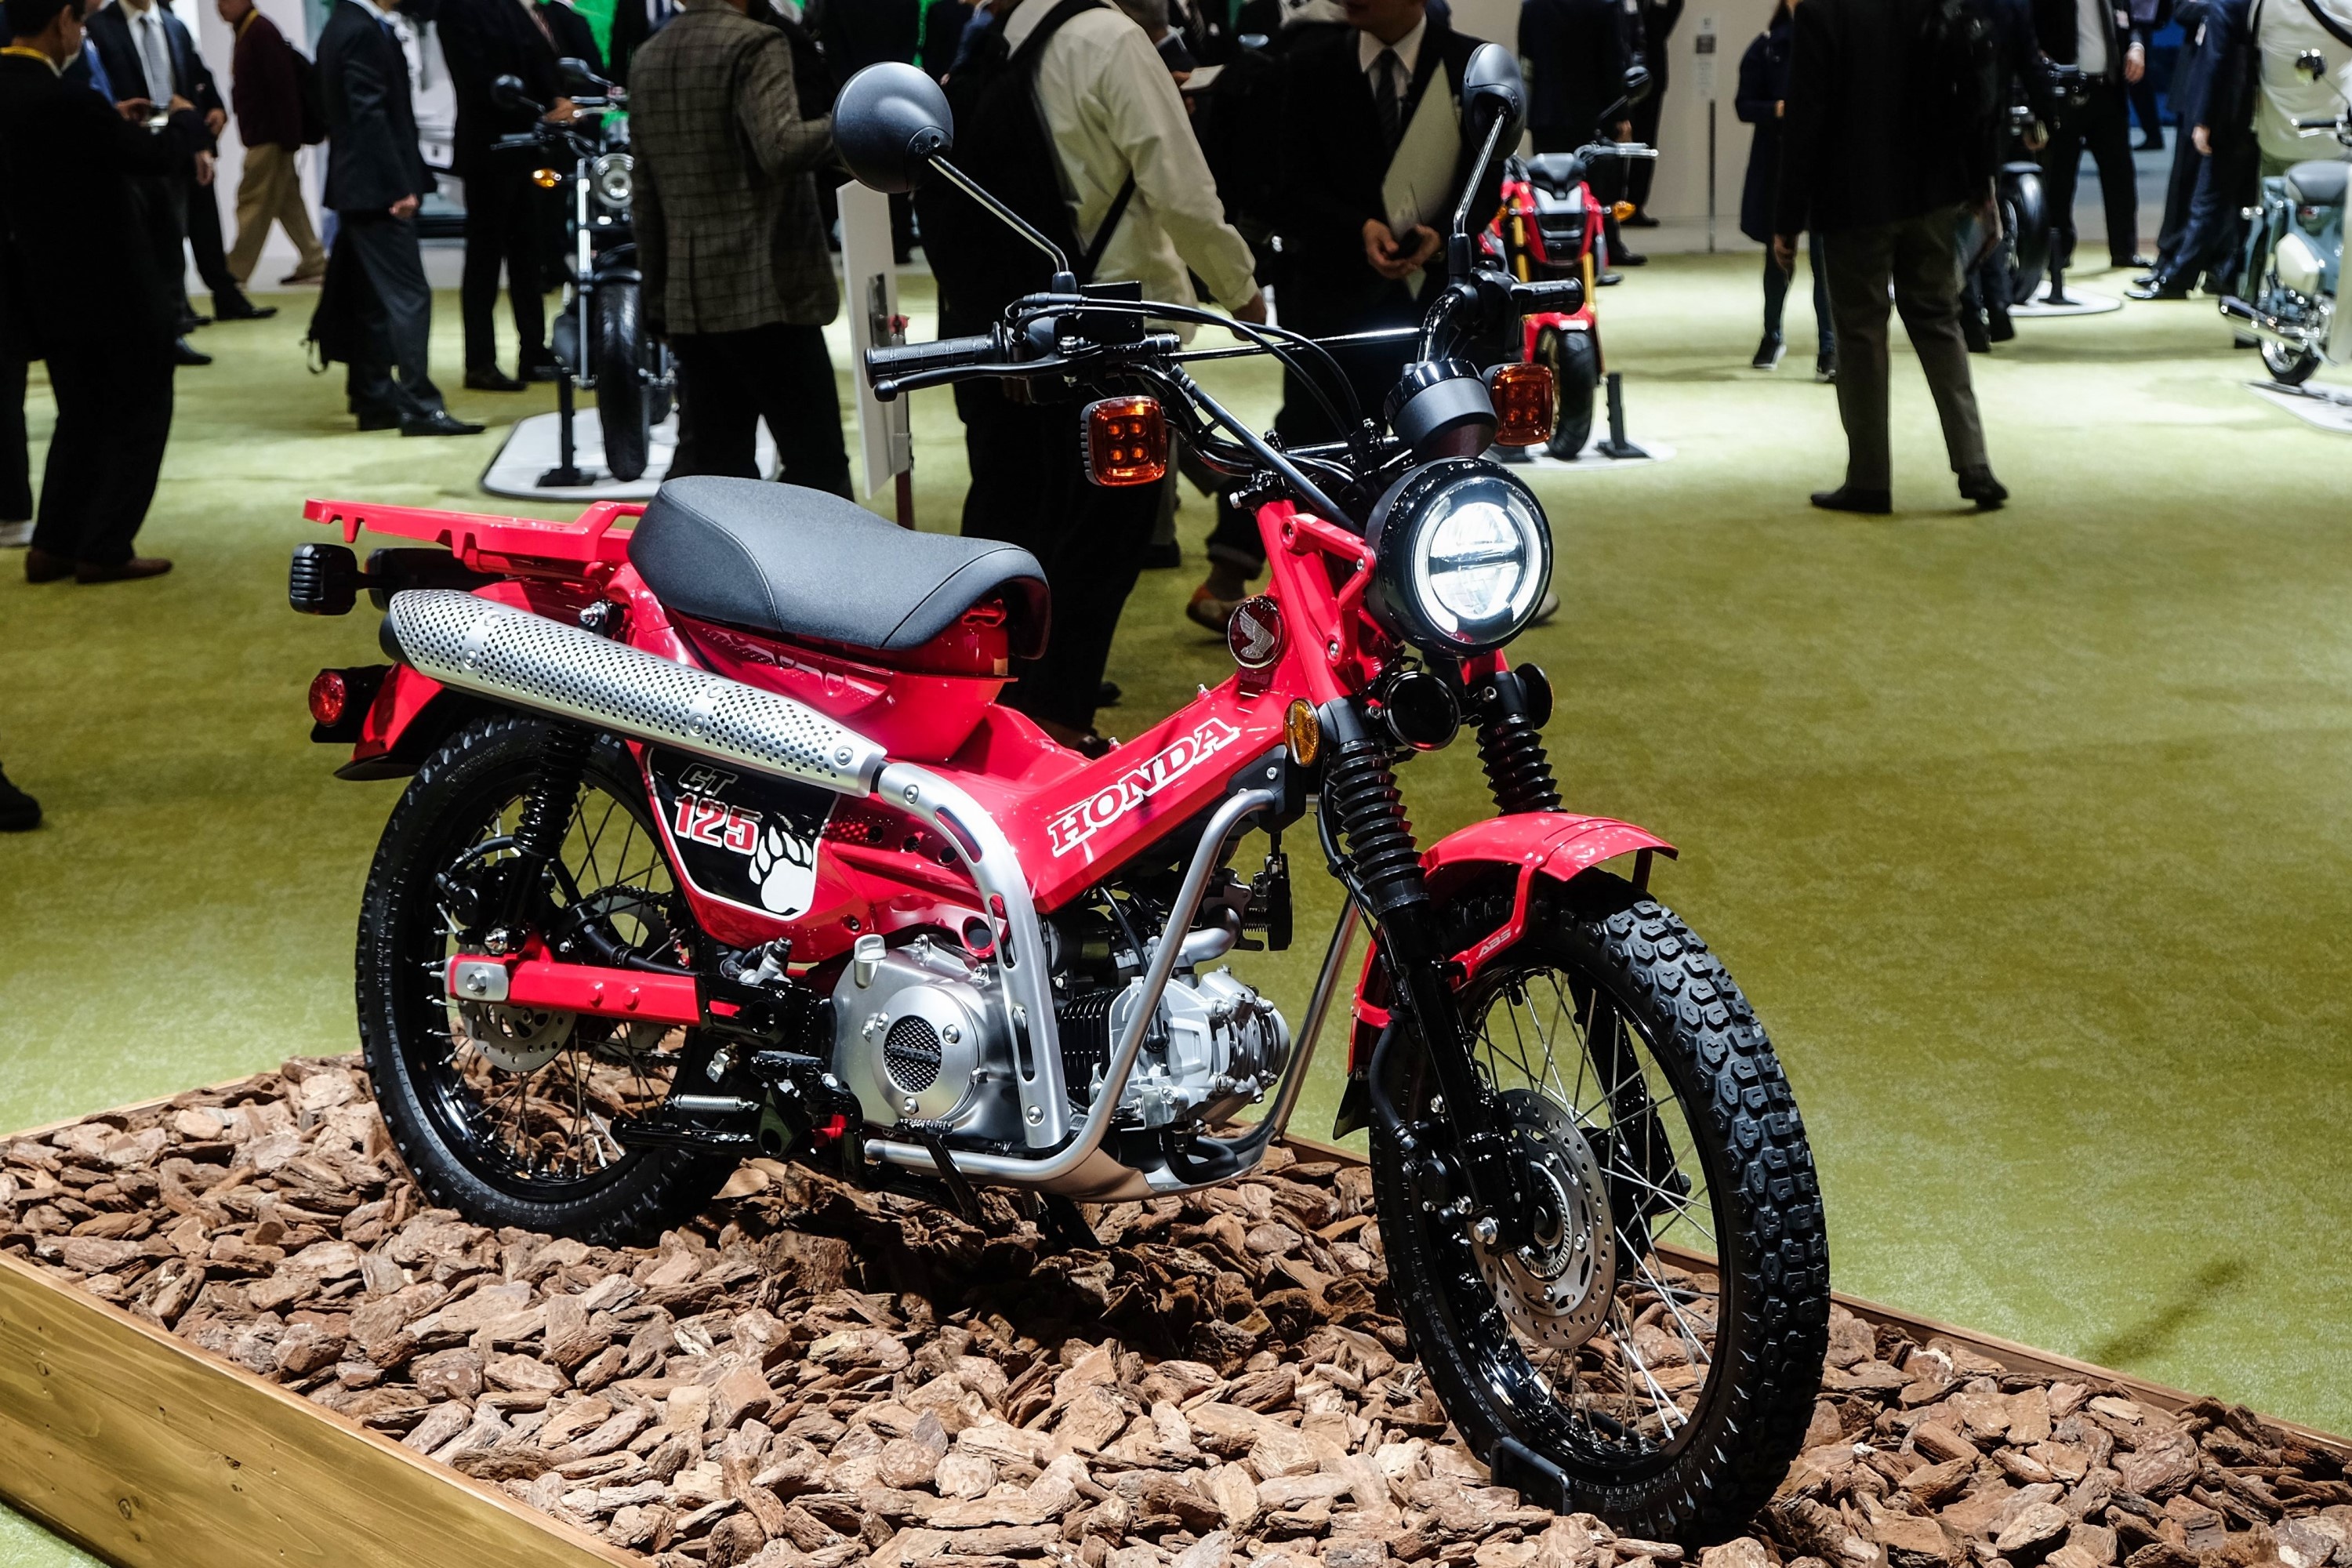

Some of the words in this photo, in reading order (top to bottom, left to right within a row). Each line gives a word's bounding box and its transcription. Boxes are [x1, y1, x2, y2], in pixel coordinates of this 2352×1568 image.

[677, 763, 739, 797] CT
[1047, 717, 1240, 858] HONDA
[673, 792, 764, 856] 125
[1478, 927, 1512, 958] ABS
[889, 1044, 941, 1064] HONDA
